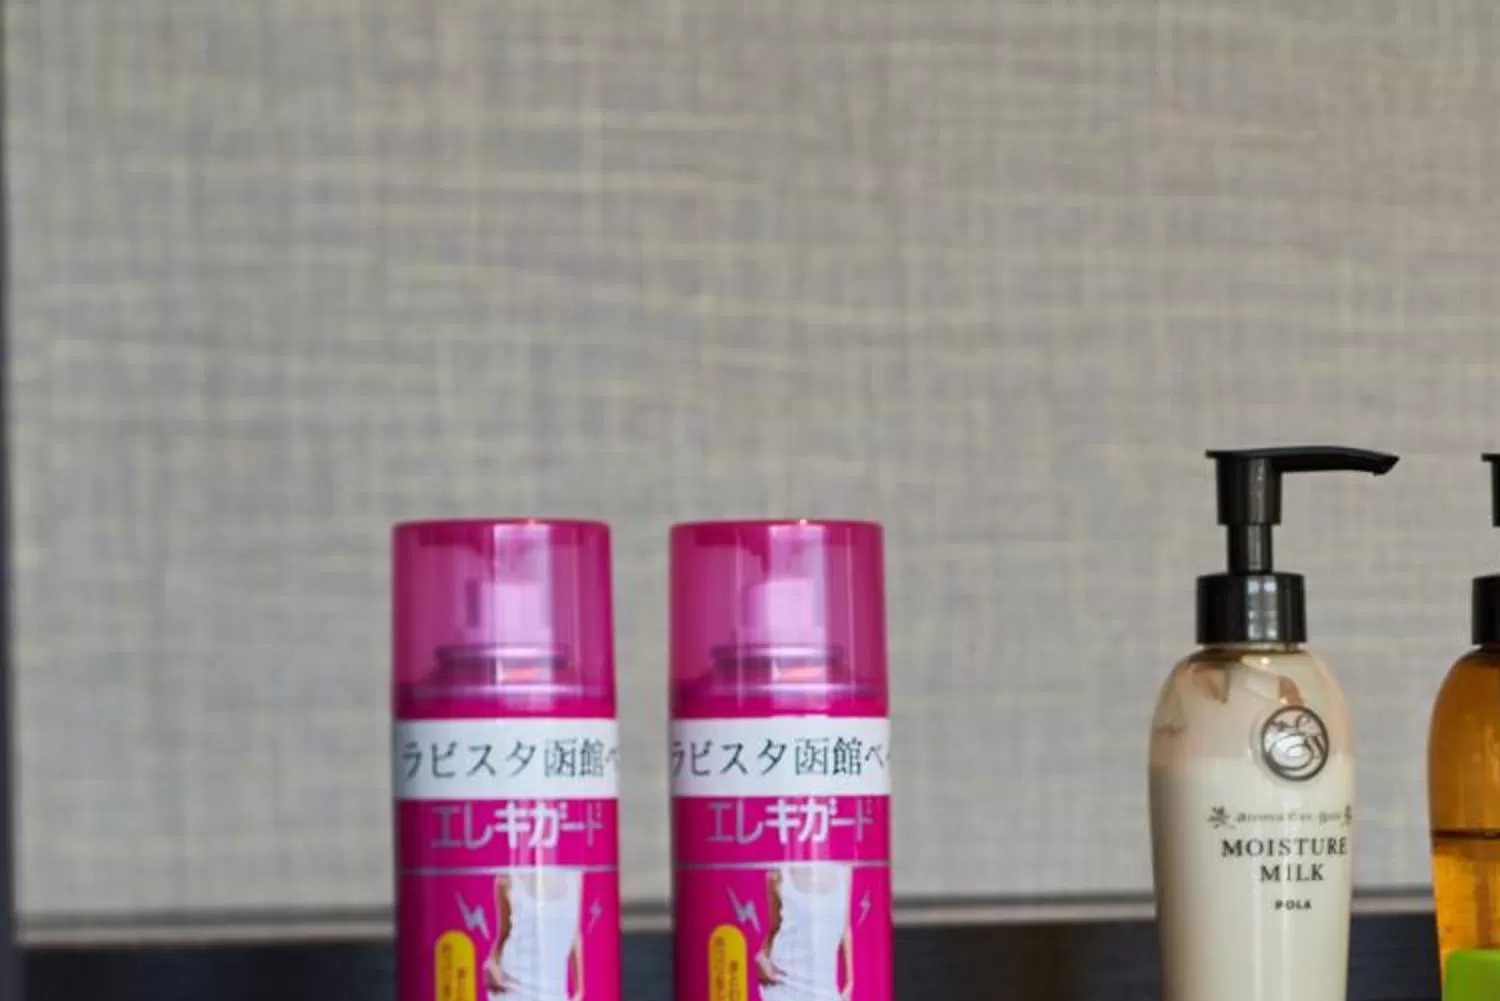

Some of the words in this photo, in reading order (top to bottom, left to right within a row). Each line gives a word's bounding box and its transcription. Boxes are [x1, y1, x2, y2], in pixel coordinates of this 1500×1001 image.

[1221, 837, 1347, 858] MOISTURE
[1260, 863, 1324, 882] MILK
[1275, 900, 1312, 910] POLA
